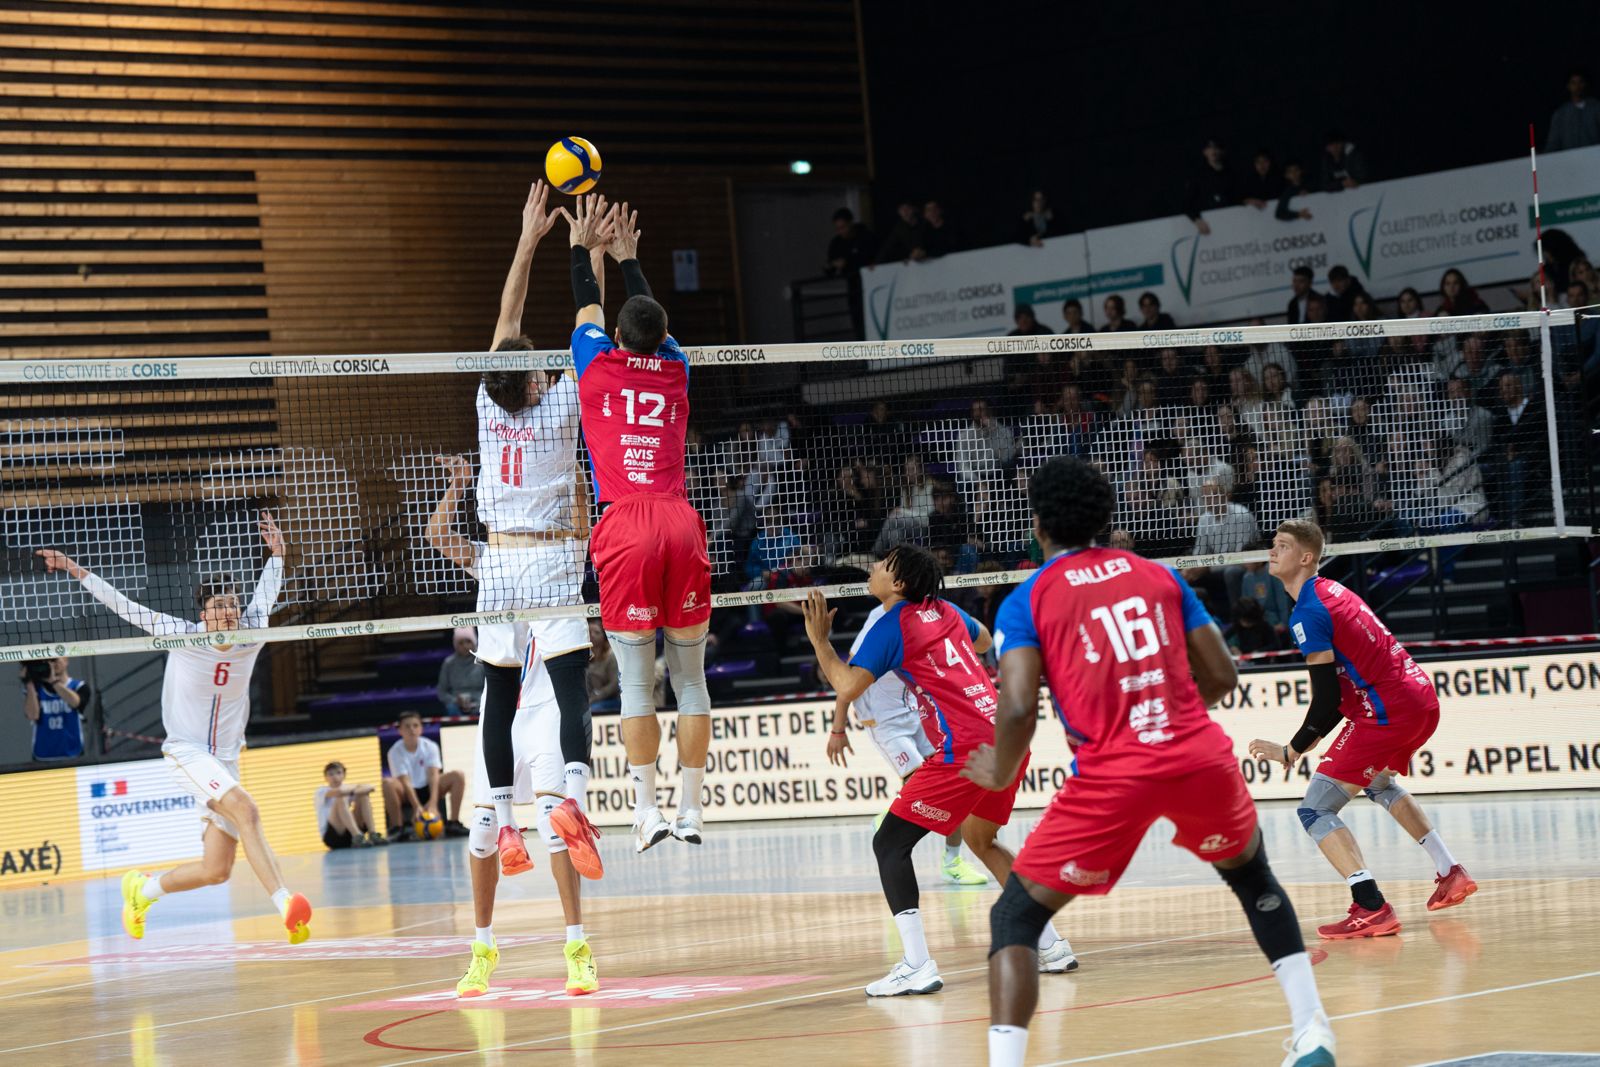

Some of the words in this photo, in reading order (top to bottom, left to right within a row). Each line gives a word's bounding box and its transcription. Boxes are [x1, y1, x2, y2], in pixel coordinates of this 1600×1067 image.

[1459, 202, 1518, 224] CORSICA
[1273, 232, 1327, 253] CORSICA
[1476, 223, 1520, 244] CORSE
[1346, 324, 1385, 336] CORSICA
[1493, 316, 1521, 328] CORSE
[1050, 337, 1093, 350] CORSICA
[1212, 331, 1243, 343] CORSE
[717, 349, 766, 362] CORSICA
[900, 343, 935, 355] CORSE
[249, 357, 321, 376] CULLETTIVITÀ
[333, 359, 390, 374] CORSICA
[456, 350, 530, 371] COLLECTIVITÉ
[23, 361, 112, 380] COLLECTIVITÉ
[131, 363, 178, 378] CORSE
[620, 388, 666, 427] 12
[623, 448, 654, 460] AVIS
[500, 445, 523, 489] 11
[956, 576, 980, 588] Gamm
[983, 573, 999, 585] vert
[1064, 557, 1133, 587] SALLES
[716, 593, 743, 607] Gamm
[745, 592, 765, 604] vert
[451, 615, 480, 627] Gamm
[484, 613, 503, 625] vert
[306, 626, 337, 638] Gamm
[341, 623, 362, 635] vert
[1091, 596, 1160, 664] 16
[153, 637, 186, 650] Gamm
[190, 635, 213, 647] vert
[0, 650, 23, 660] amm
[28, 646, 52, 658] vert
[944, 637, 973, 675] 4
[213, 661, 231, 687] 6
[1433, 665, 1536, 700] RGENT,
[758, 713, 783, 738] ET
[789, 711, 816, 734] DE
[1465, 745, 1560, 775] APPEL
[732, 778, 838, 805] CONSEILS
[844, 776, 889, 800] SUR
